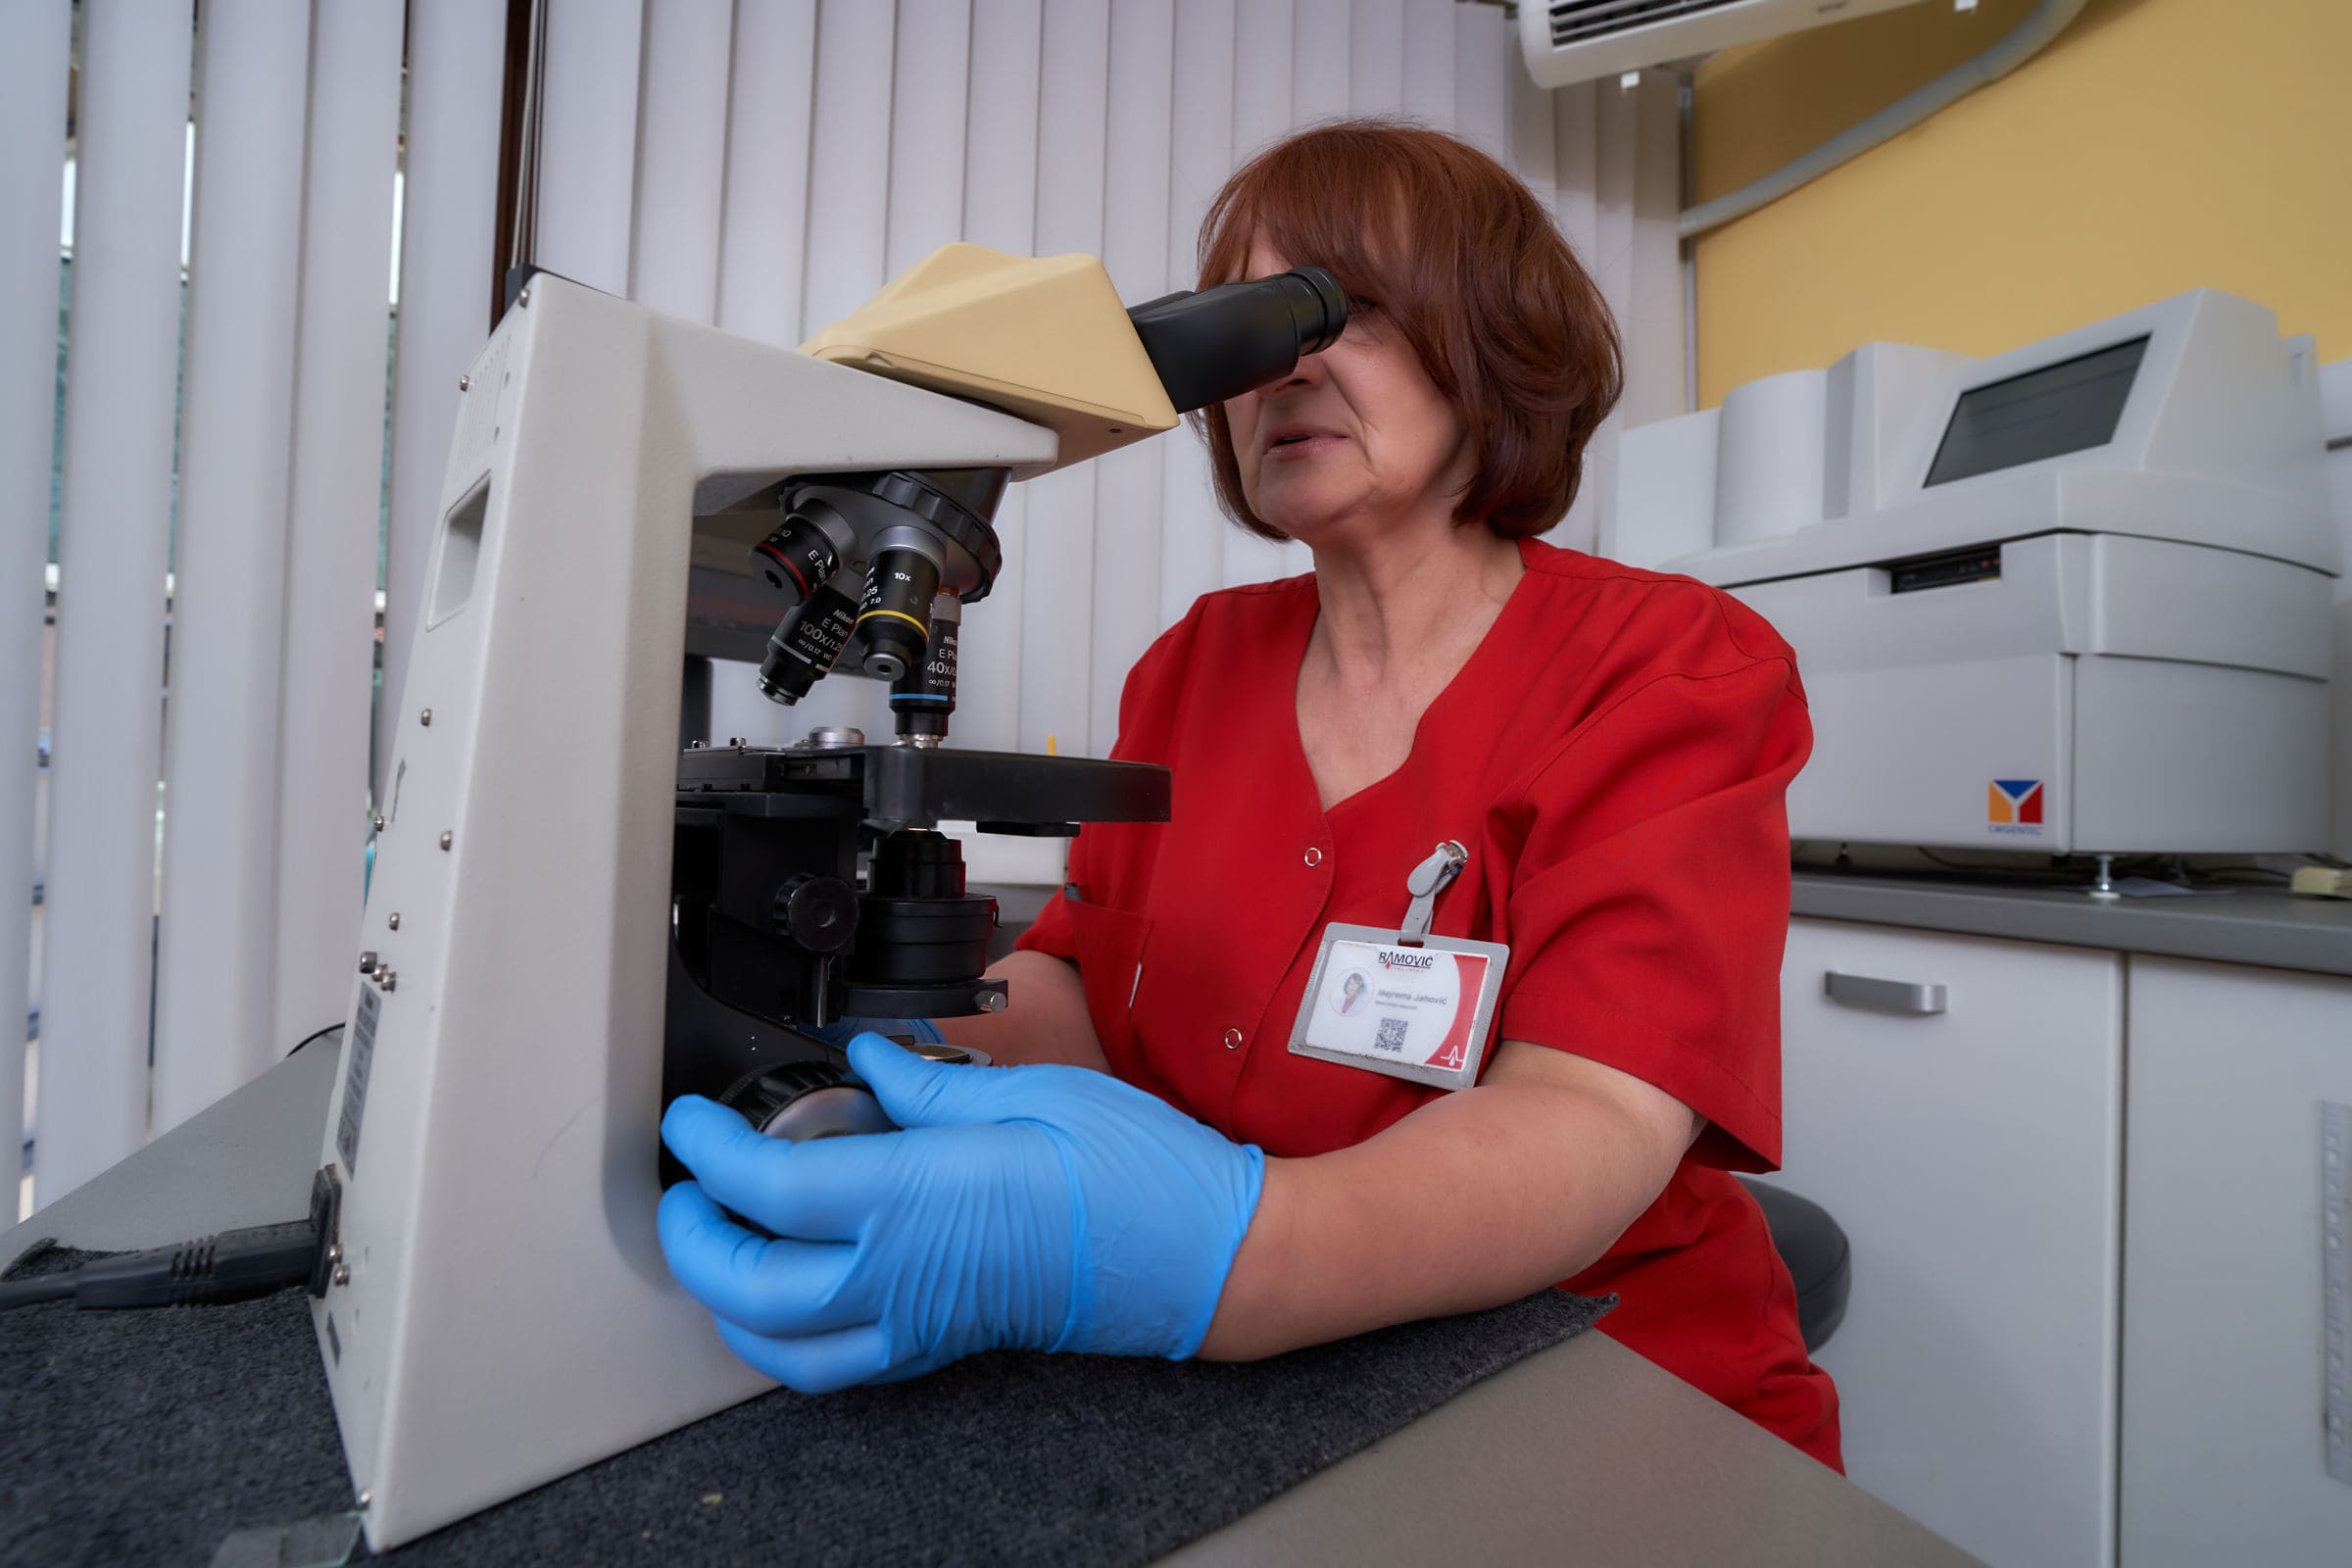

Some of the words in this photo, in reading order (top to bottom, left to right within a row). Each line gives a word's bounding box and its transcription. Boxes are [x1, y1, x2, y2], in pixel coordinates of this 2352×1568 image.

[808, 550, 819, 561] E
[833, 609, 855, 624] Nikon
[821, 617, 832, 628] E
[831, 623, 849, 637] Plan
[939, 648, 947, 659] E
[1378, 951, 1434, 967] RAMOVIĆ
